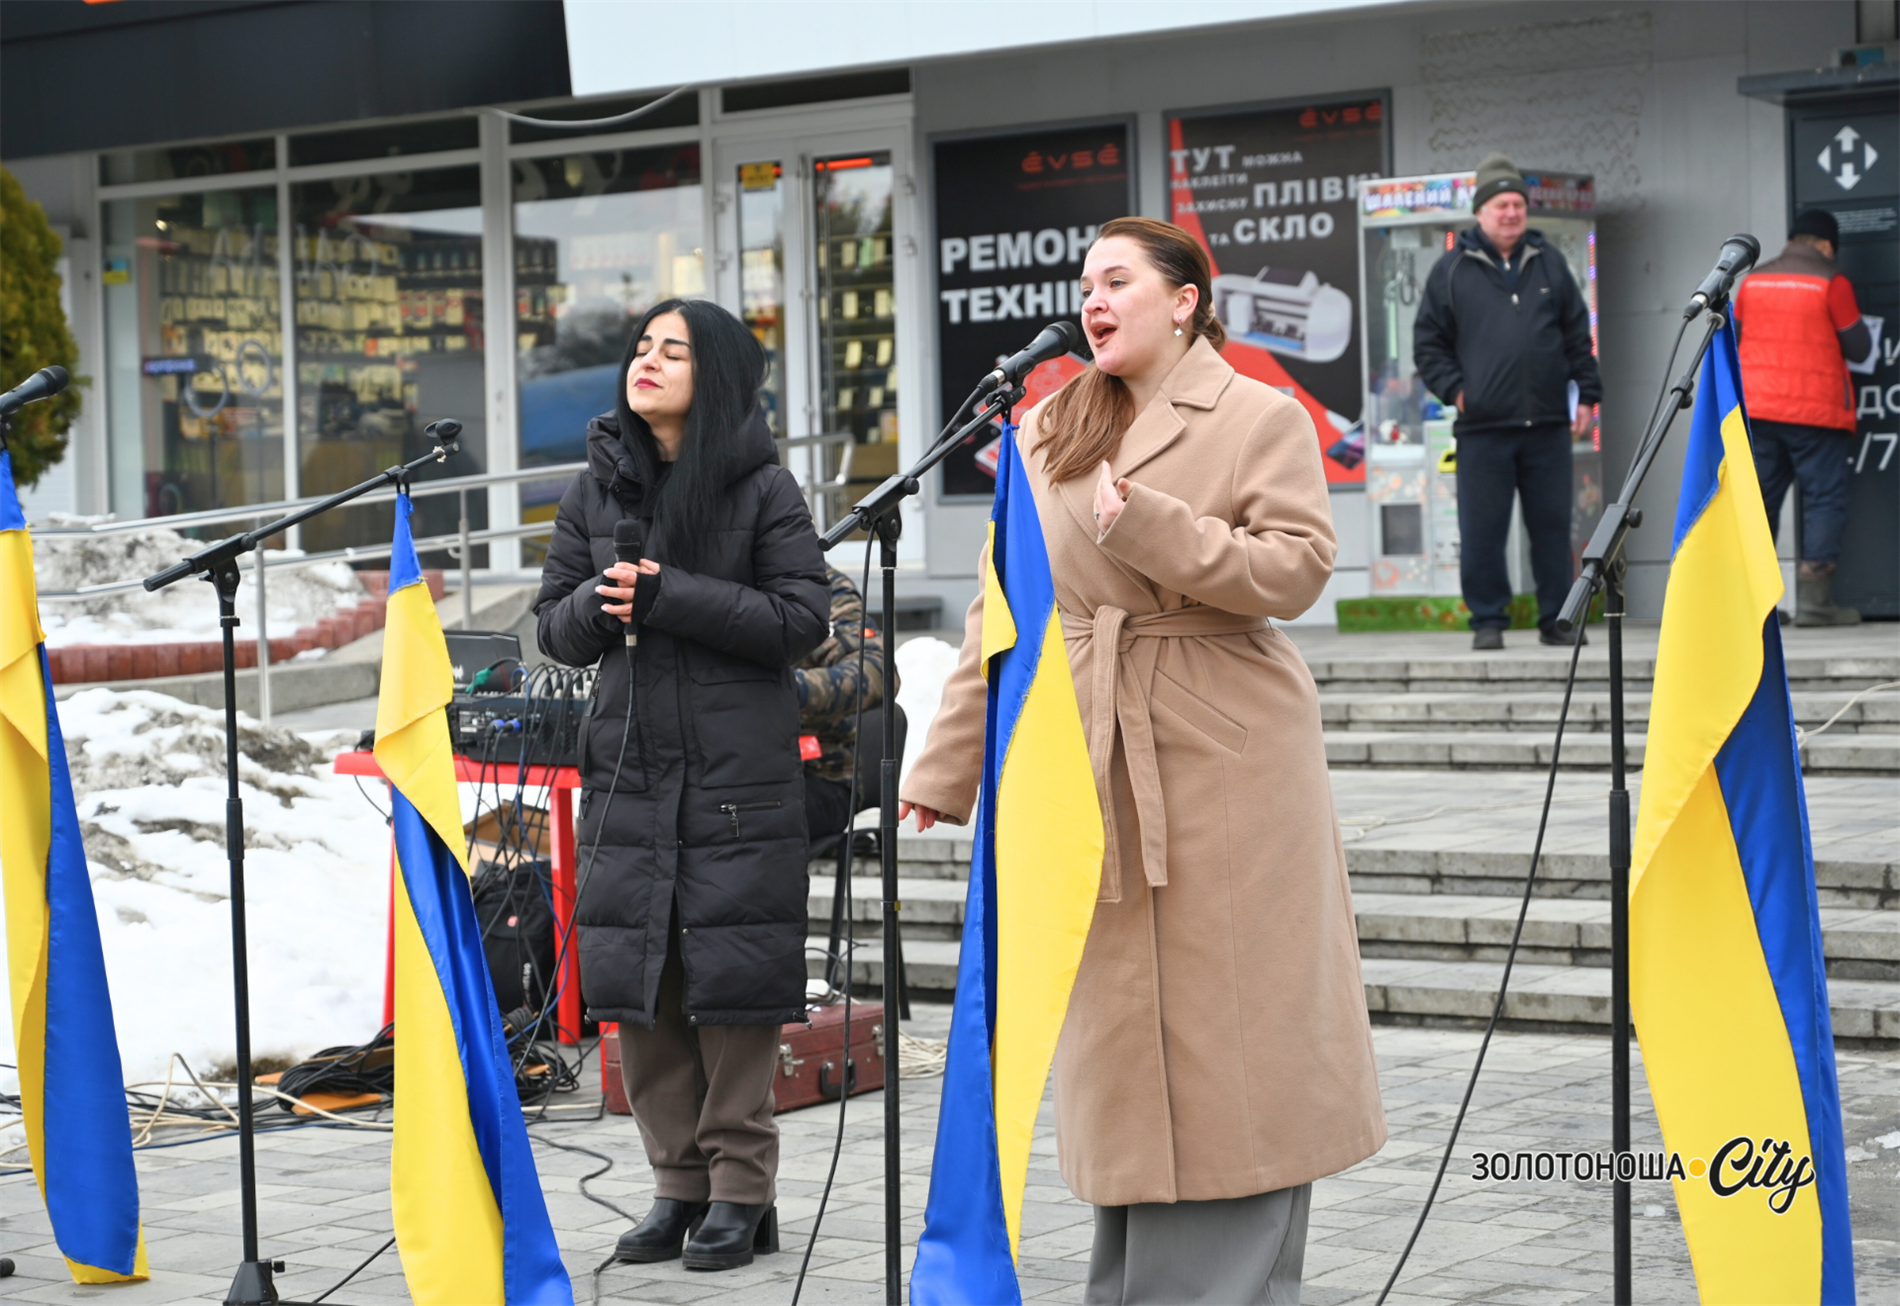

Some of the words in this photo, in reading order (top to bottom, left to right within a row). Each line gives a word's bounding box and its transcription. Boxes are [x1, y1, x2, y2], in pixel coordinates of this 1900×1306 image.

[1170, 144, 1236, 173] ТУТ
[1242, 150, 1303, 168] МОЖНА
[1253, 172, 1381, 208] ПЛІВК
[1208, 233, 1230, 247] ТА
[1233, 211, 1335, 245] СКЛО
[940, 223, 1102, 275] РЕМОН
